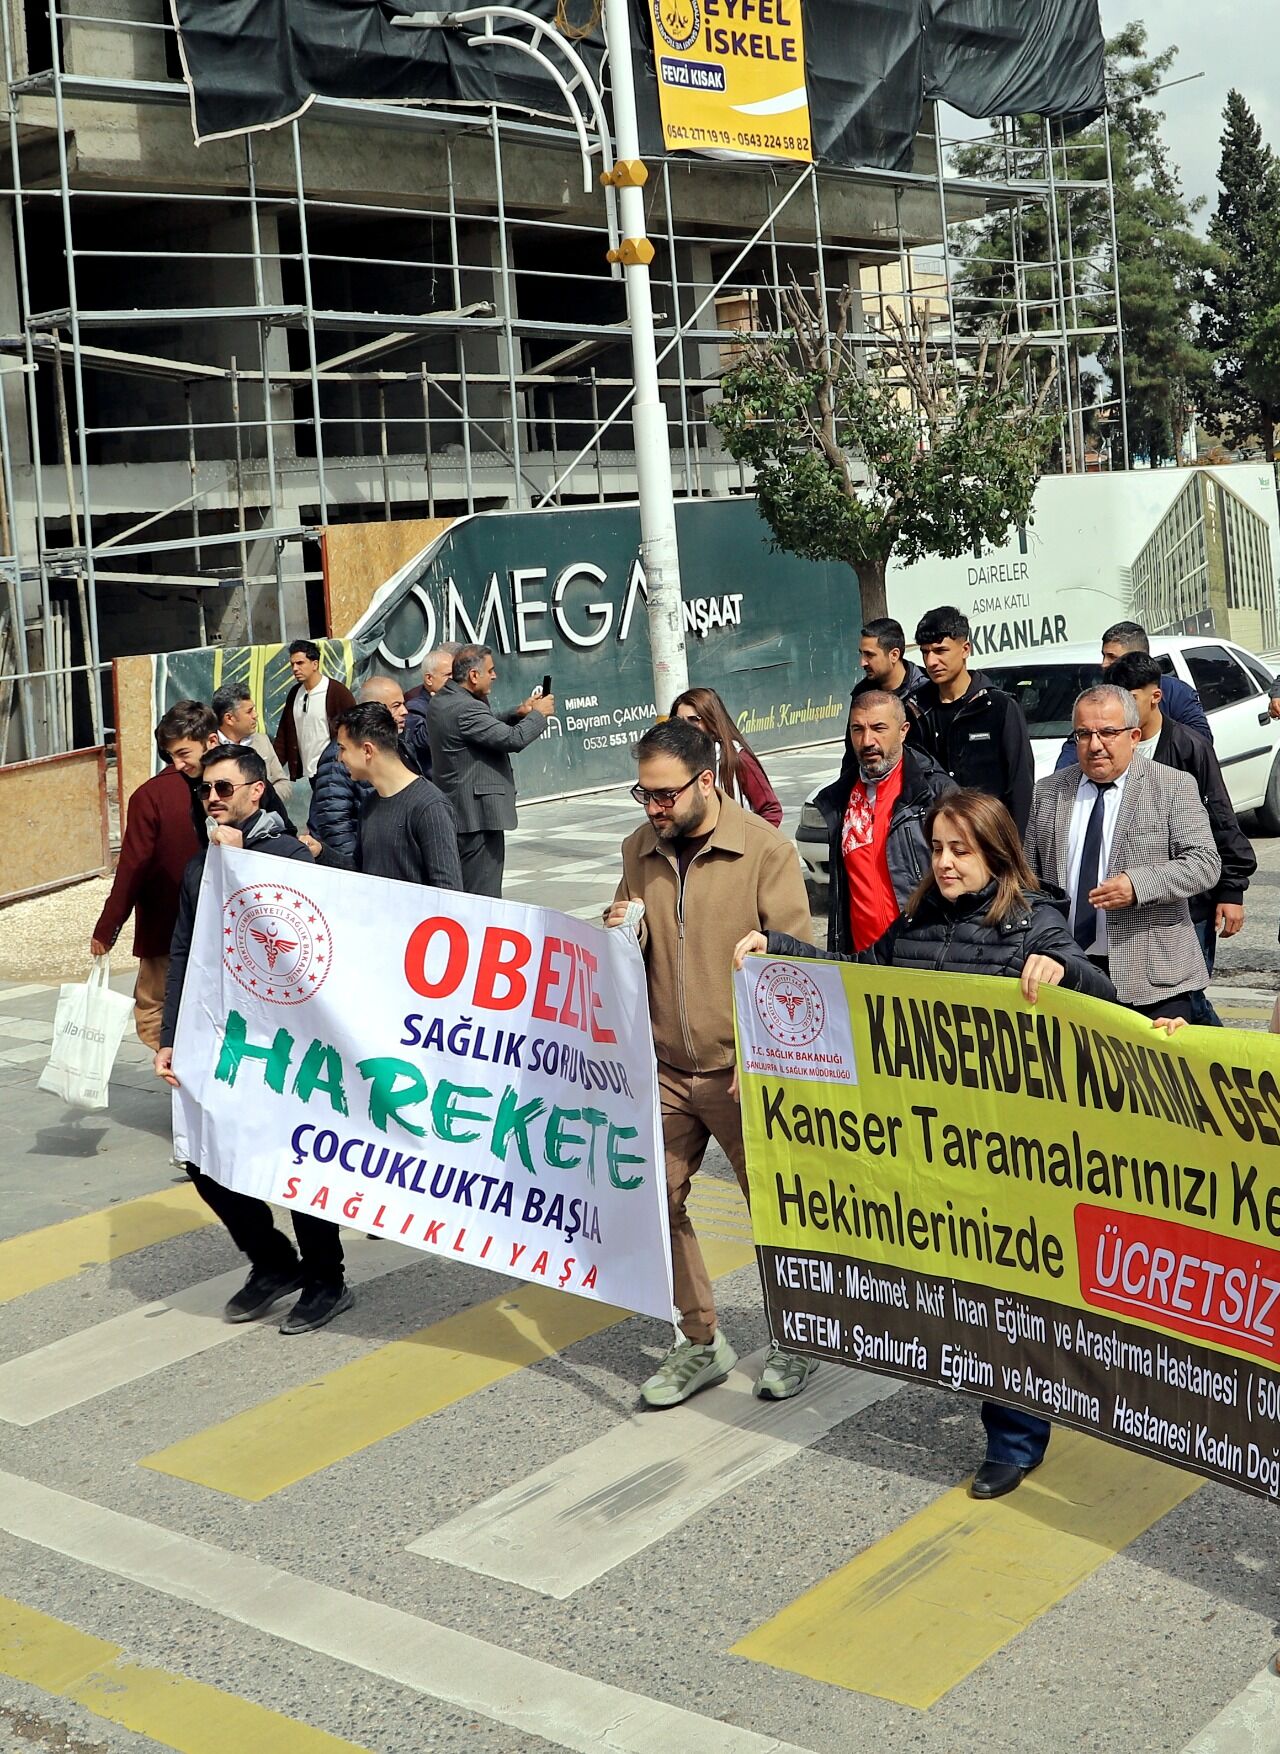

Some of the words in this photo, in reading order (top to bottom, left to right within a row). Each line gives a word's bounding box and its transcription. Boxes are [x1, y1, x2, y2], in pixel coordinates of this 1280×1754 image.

[704, 0, 791, 25] EYFEL
[705, 19, 798, 61] İSKELE
[662, 64, 689, 84] FEVZİ
[690, 69, 723, 89] KISAK
[667, 124, 690, 140] 0542
[691, 127, 706, 142] 277
[708, 129, 718, 142] 19
[719, 130, 730, 144] 19
[738, 132, 763, 147] 0543
[764, 134, 782, 149] 224
[784, 135, 795, 150] 58
[797, 138, 809, 150] 82
[378, 559, 651, 669] OMEGA
[682, 593, 743, 638] NŞAAT
[972, 597, 1001, 615] ASMA
[1004, 593, 1030, 610] KATLI
[968, 614, 1069, 657] KKANLAR
[566, 713, 611, 732] Bayram
[613, 703, 657, 727] ÇAKMA
[777, 694, 843, 728] Kuruluşudur
[583, 735, 608, 750] 0532
[610, 732, 628, 746] 553
[285, 913, 309, 941] SAĞLIK
[403, 916, 617, 1044] OBEZİTE
[400, 1014, 527, 1068] SAĞLIK
[752, 1046, 765, 1056] T.C.
[766, 1047, 794, 1060] SAĞLIK
[795, 1051, 843, 1065] BAKANLIĞI
[786, 1066, 809, 1077] SAĞLIK
[809, 1067, 851, 1080] MÜDÜRLÜĞÜ
[864, 993, 1067, 1103] KANSERDEN
[1068, 1021, 1224, 1137] KORKMA
[214, 1009, 647, 1190] HAREKETE
[763, 1085, 903, 1158] Kanser
[911, 1105, 1219, 1220] Taramalarınızı
[291, 1123, 514, 1219] ÇOCUKLUKTA
[521, 1187, 602, 1244] BAŞLA
[776, 1172, 1065, 1278] Hekimlerinizde
[775, 1254, 835, 1295] KETEM
[846, 1264, 910, 1311] Mehmet
[915, 1280, 946, 1319] Akif
[952, 1278, 989, 1329] İnan
[994, 1296, 1047, 1346] Eğitim
[1054, 1323, 1073, 1352] ve
[1075, 1327, 1154, 1378] Araştırma
[1156, 1342, 1238, 1408] Hastanesi
[782, 1310, 841, 1350] KETEM
[853, 1324, 928, 1371] Şanlıurfa
[940, 1343, 994, 1393] Eğitim
[1001, 1366, 1021, 1395] ve
[1024, 1367, 1100, 1424] Araştırma
[1112, 1394, 1191, 1454] Hastanesi
[1195, 1424, 1243, 1475] Kadın
